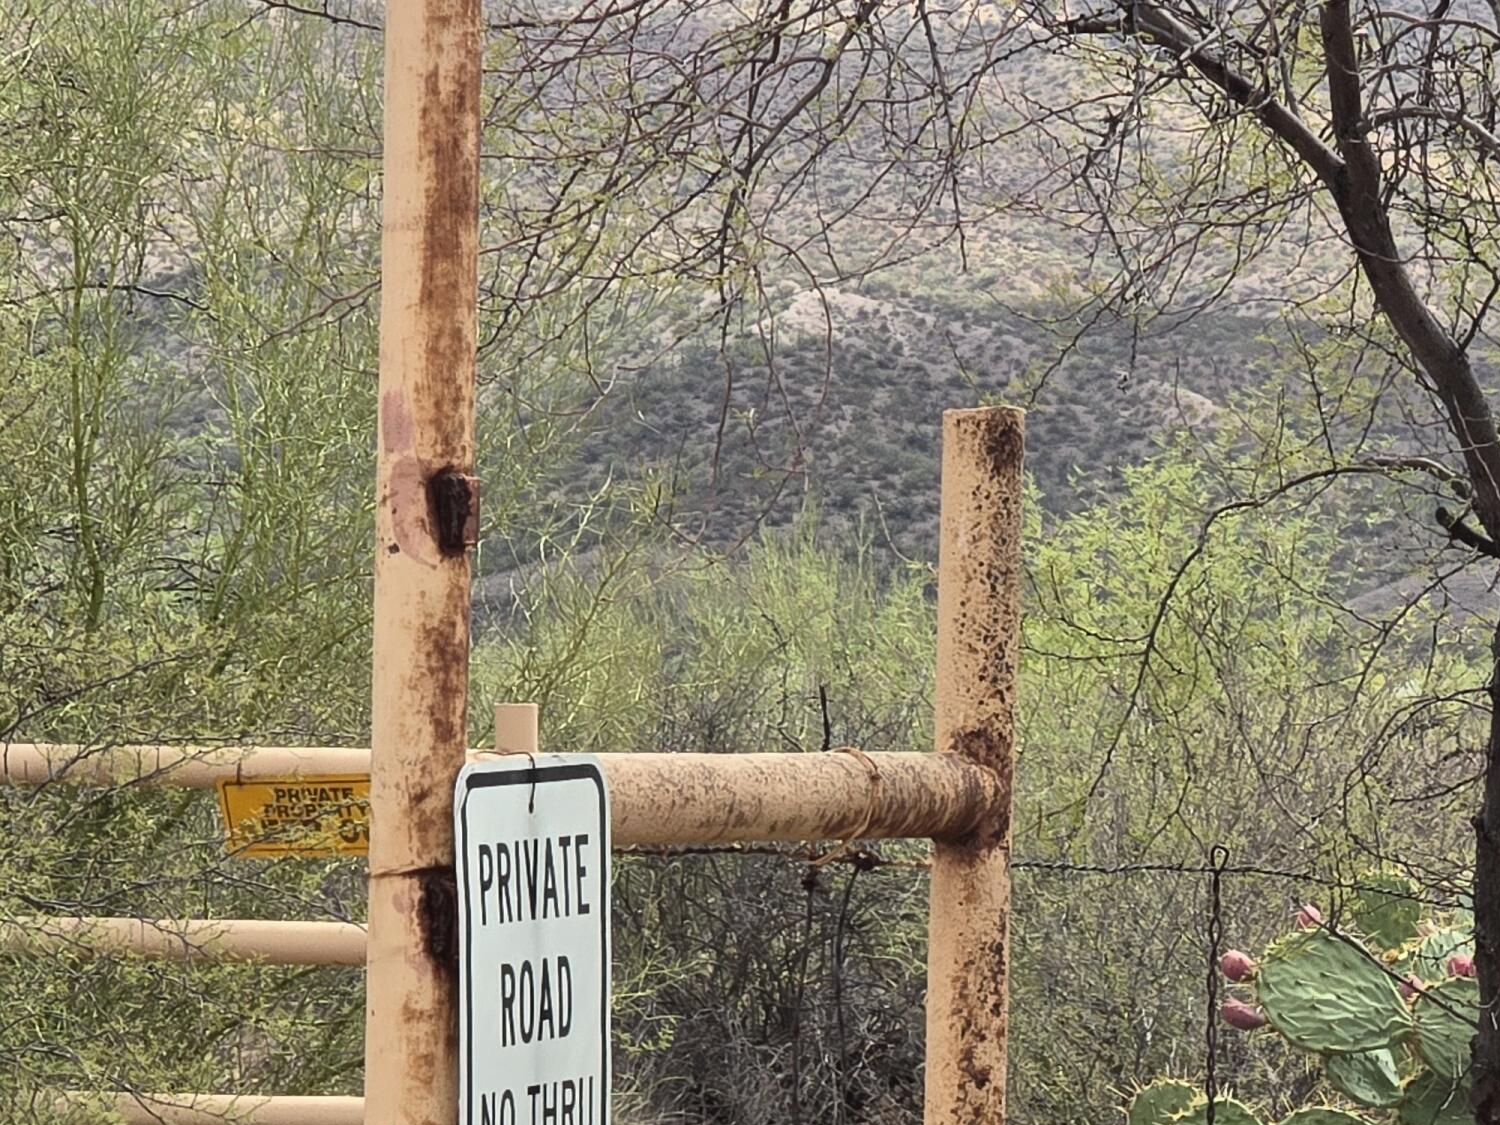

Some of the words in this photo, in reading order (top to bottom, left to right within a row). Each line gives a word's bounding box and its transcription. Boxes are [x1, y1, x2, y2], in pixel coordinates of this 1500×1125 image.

[263, 803, 369, 818] PROPTY
[274, 787, 354, 802] PRIVATE
[479, 834, 590, 926] PRIVATE
[501, 955, 573, 1047] ROAD
